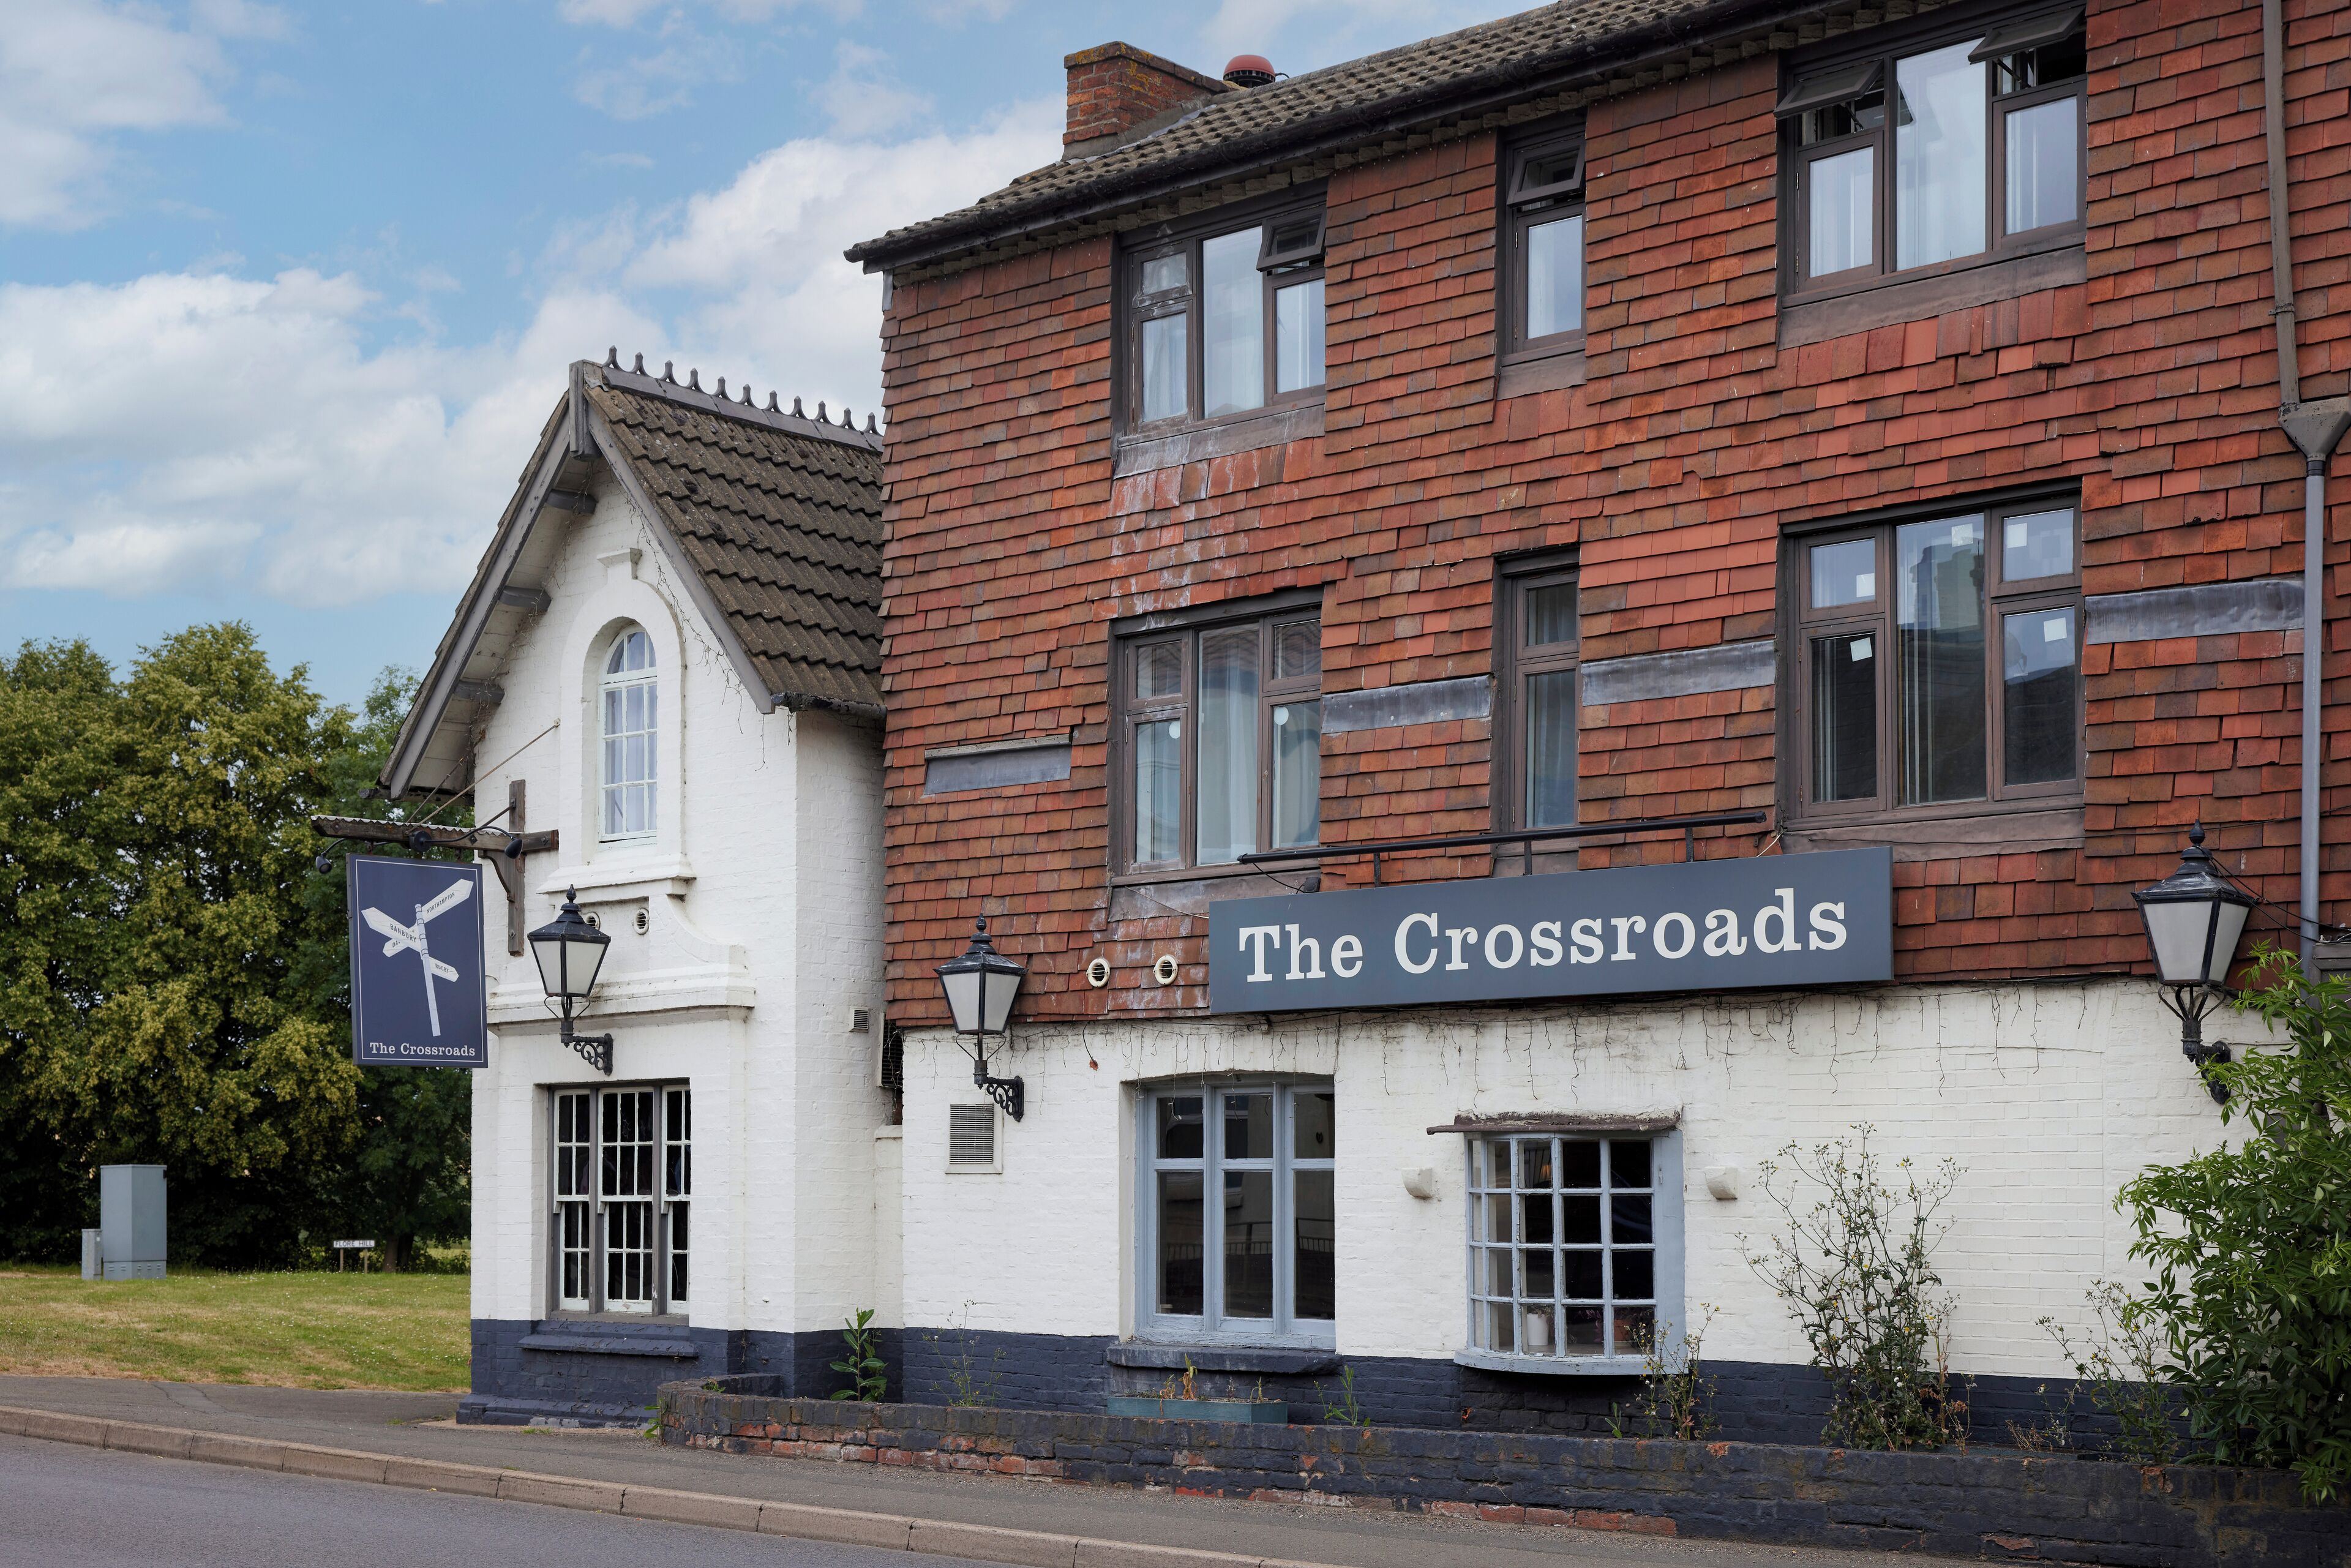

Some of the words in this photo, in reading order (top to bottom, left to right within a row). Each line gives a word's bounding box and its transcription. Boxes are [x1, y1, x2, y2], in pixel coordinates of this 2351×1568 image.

[426, 891, 455, 913] NORTHAMPTON
[390, 923, 416, 942] BANBURY
[1239, 923, 1363, 983] The
[1394, 887, 1847, 974] Crossroads
[435, 963, 449, 973] RUGBY
[369, 1042, 396, 1054] The
[400, 1043, 475, 1056] Crossroads
